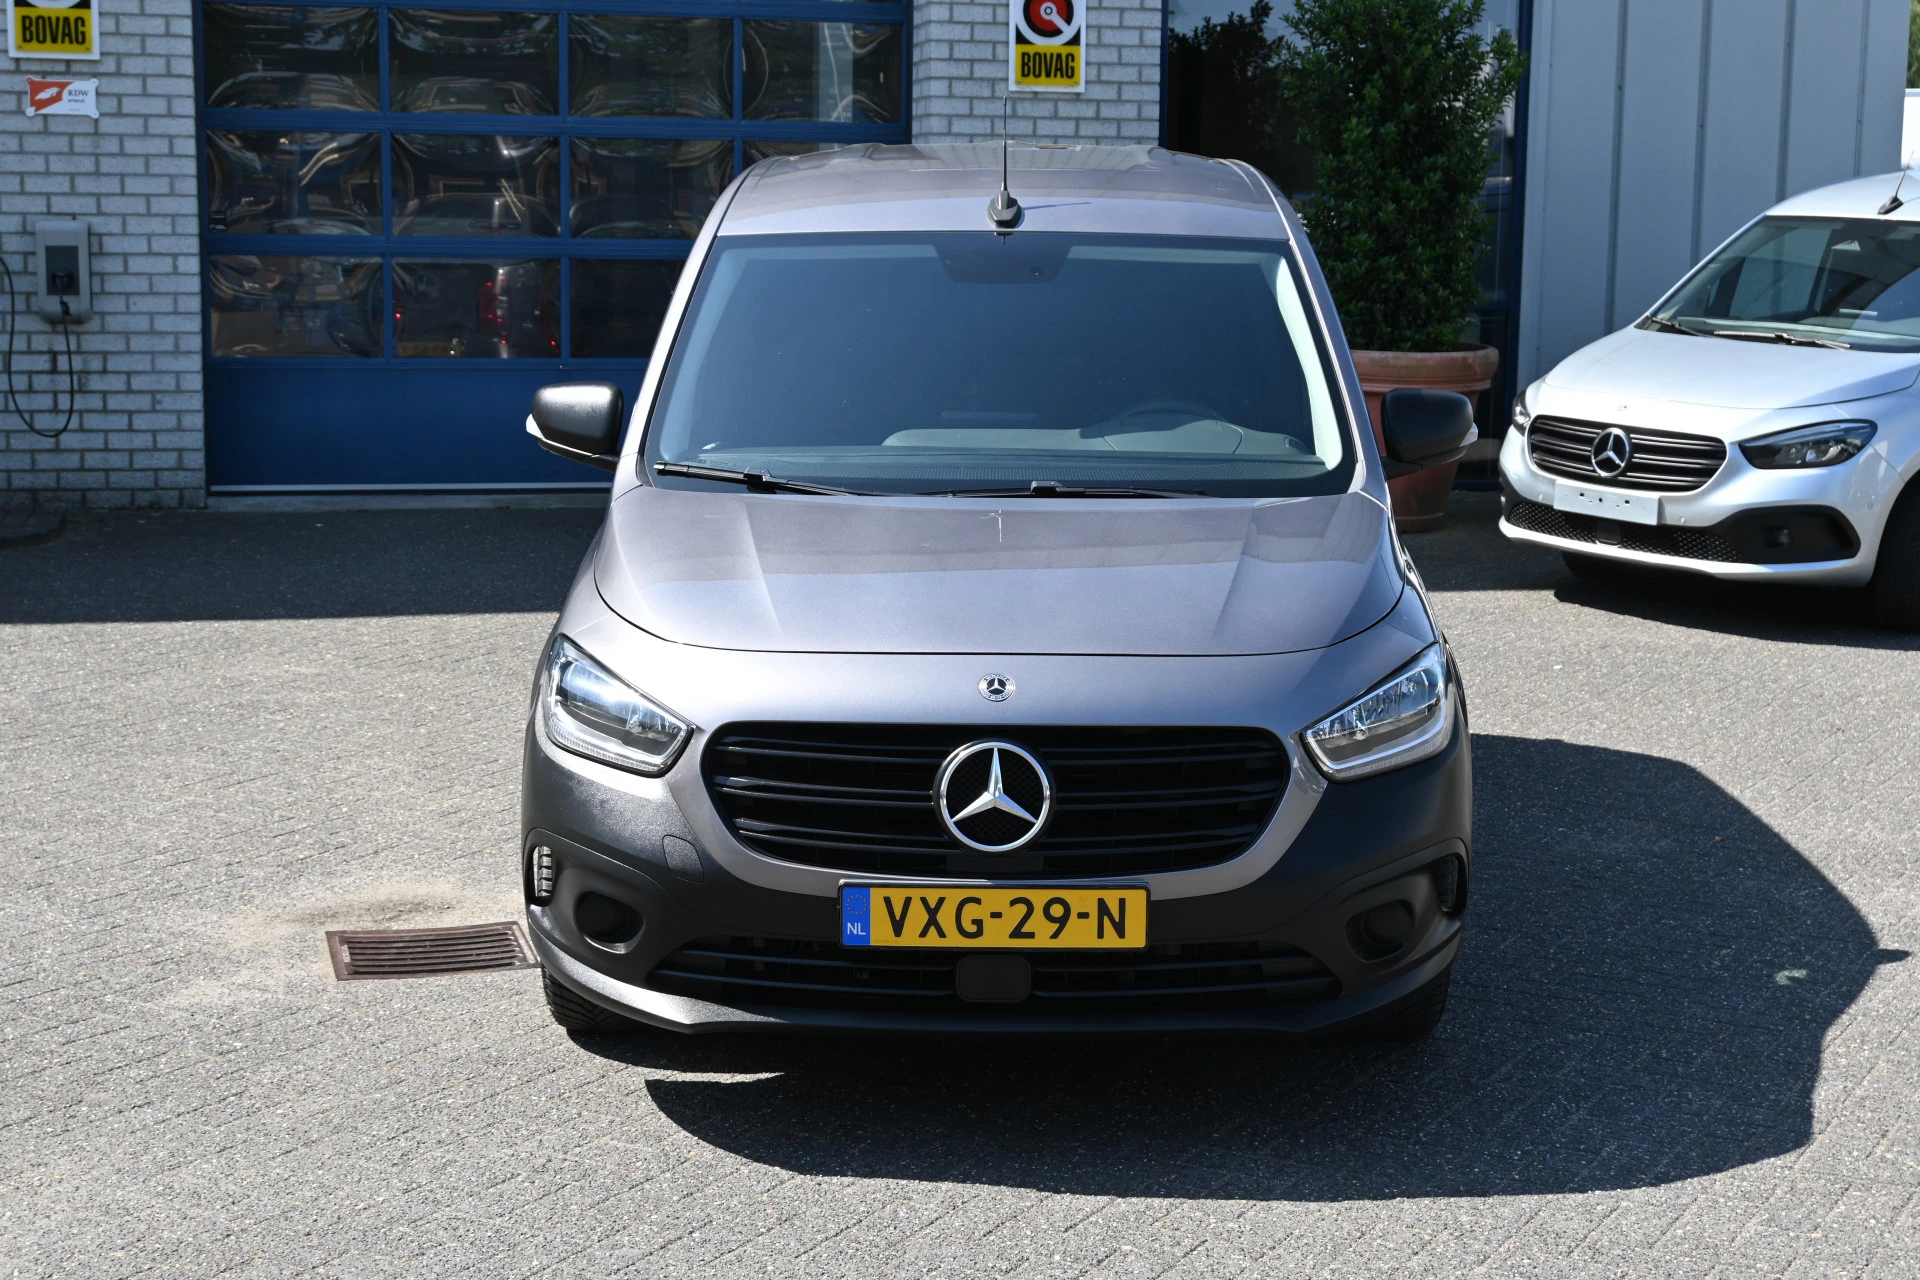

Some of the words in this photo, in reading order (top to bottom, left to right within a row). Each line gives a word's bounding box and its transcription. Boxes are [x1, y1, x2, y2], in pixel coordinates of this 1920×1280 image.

[21, 15, 87, 45] BOVAG
[1021, 52, 1075, 79] BOVAG
[68, 89, 90, 97] RDW
[847, 922, 866, 935] NL
[883, 896, 1126, 940] VXG-29-N
